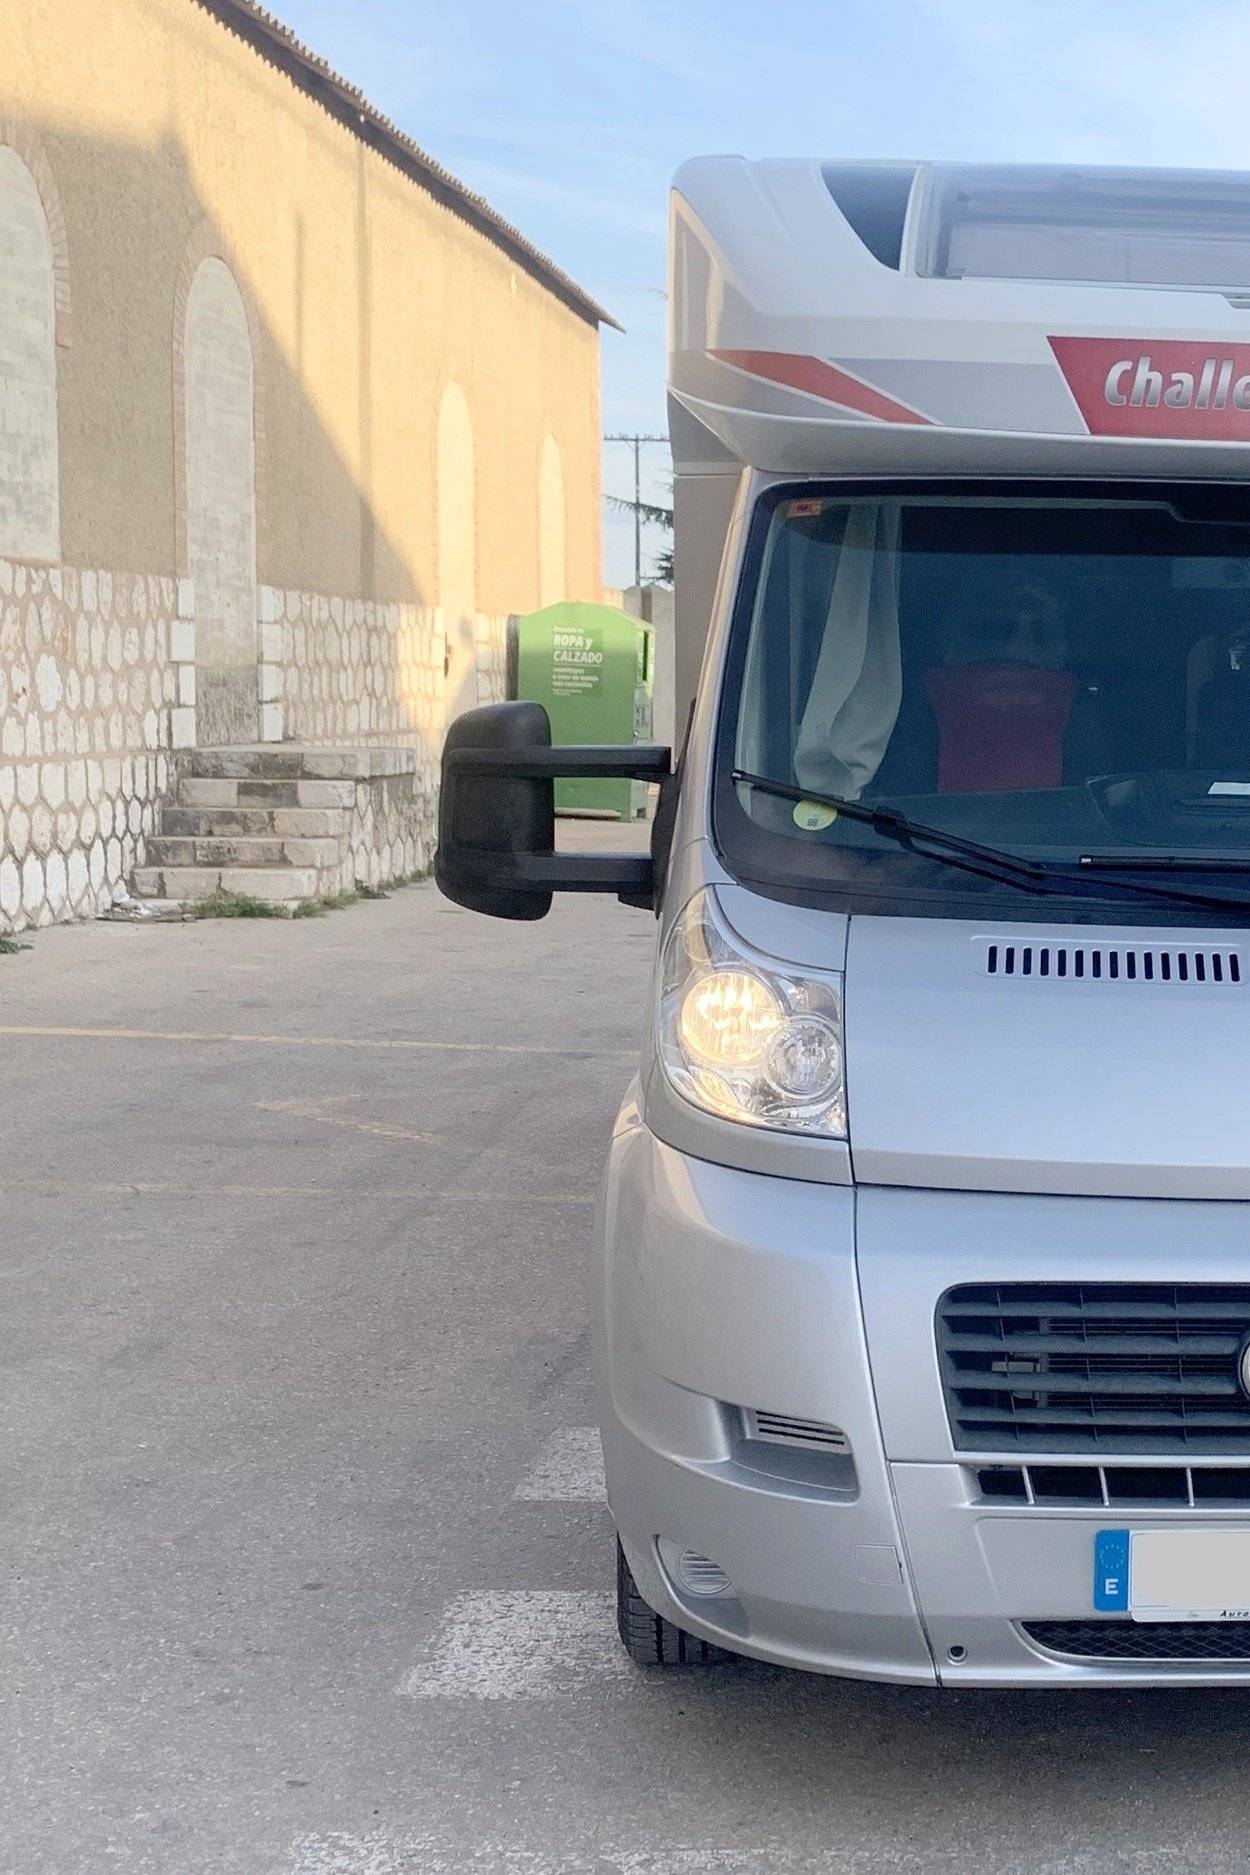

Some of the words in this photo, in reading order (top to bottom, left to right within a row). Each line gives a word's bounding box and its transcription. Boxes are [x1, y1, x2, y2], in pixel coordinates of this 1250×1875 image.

[553, 634, 584, 647] ROPA
[553, 650, 603, 664] CALZADO
[1104, 1578, 1119, 1595] E
